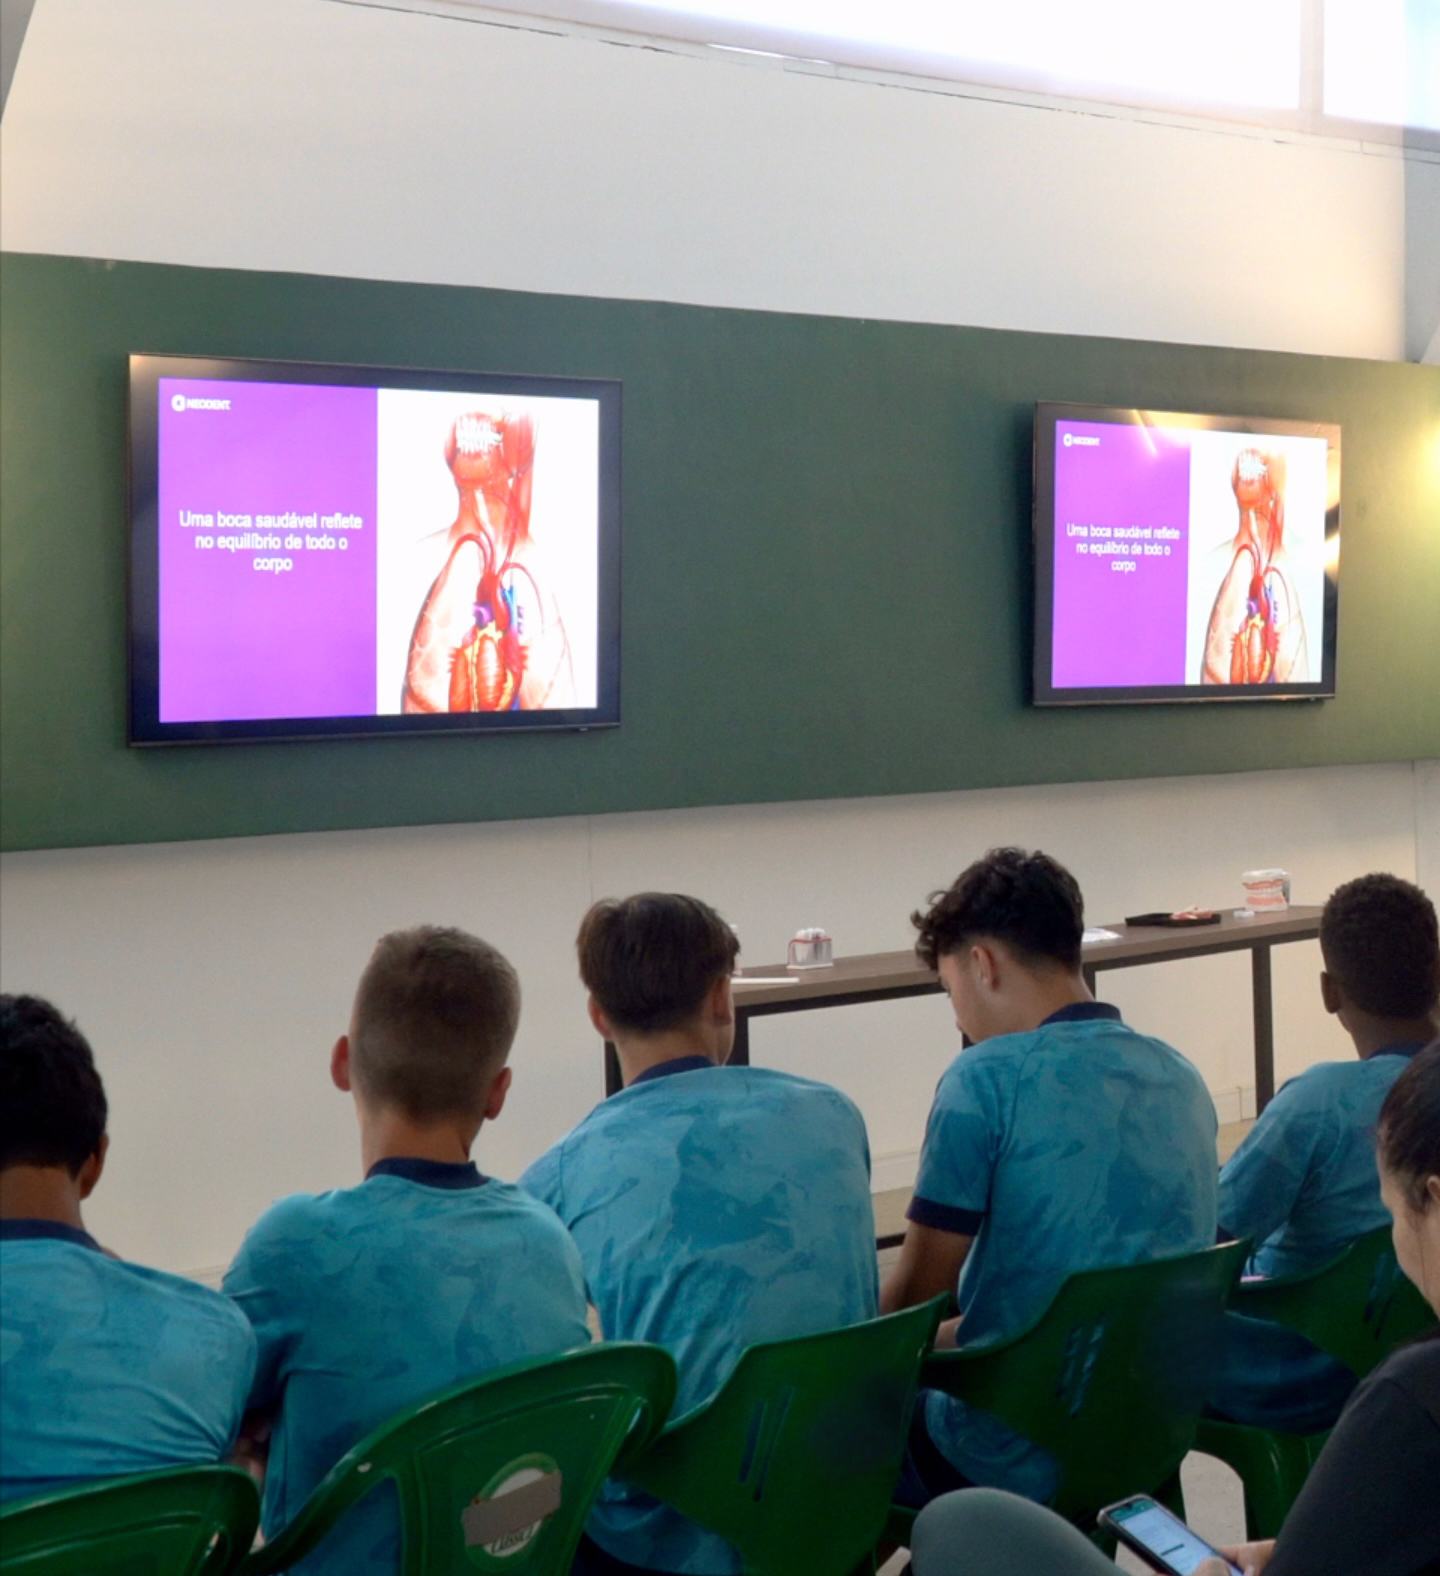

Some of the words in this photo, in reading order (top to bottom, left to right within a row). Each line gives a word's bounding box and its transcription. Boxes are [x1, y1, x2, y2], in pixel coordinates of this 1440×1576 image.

[179, 510, 213, 527] Uma
[217, 511, 251, 528] boca
[255, 512, 317, 529] saudável
[320, 513, 363, 529] reflete
[1066, 523, 1088, 537] Uma
[1090, 524, 1111, 538] boca
[1113, 525, 1152, 539] saudável
[1153, 526, 1180, 540] reflete
[195, 535, 214, 549] no
[217, 533, 281, 553] equilíbrio
[284, 533, 302, 549] de
[306, 534, 335, 550] todo
[338, 538, 348, 550] o
[1076, 543, 1088, 554] no
[1090, 541, 1129, 557] equilíbrio
[1131, 542, 1142, 555] de
[1144, 543, 1162, 555] todo
[1164, 546, 1171, 555] o
[253, 557, 293, 575] corpo
[1111, 560, 1136, 574] corpo
